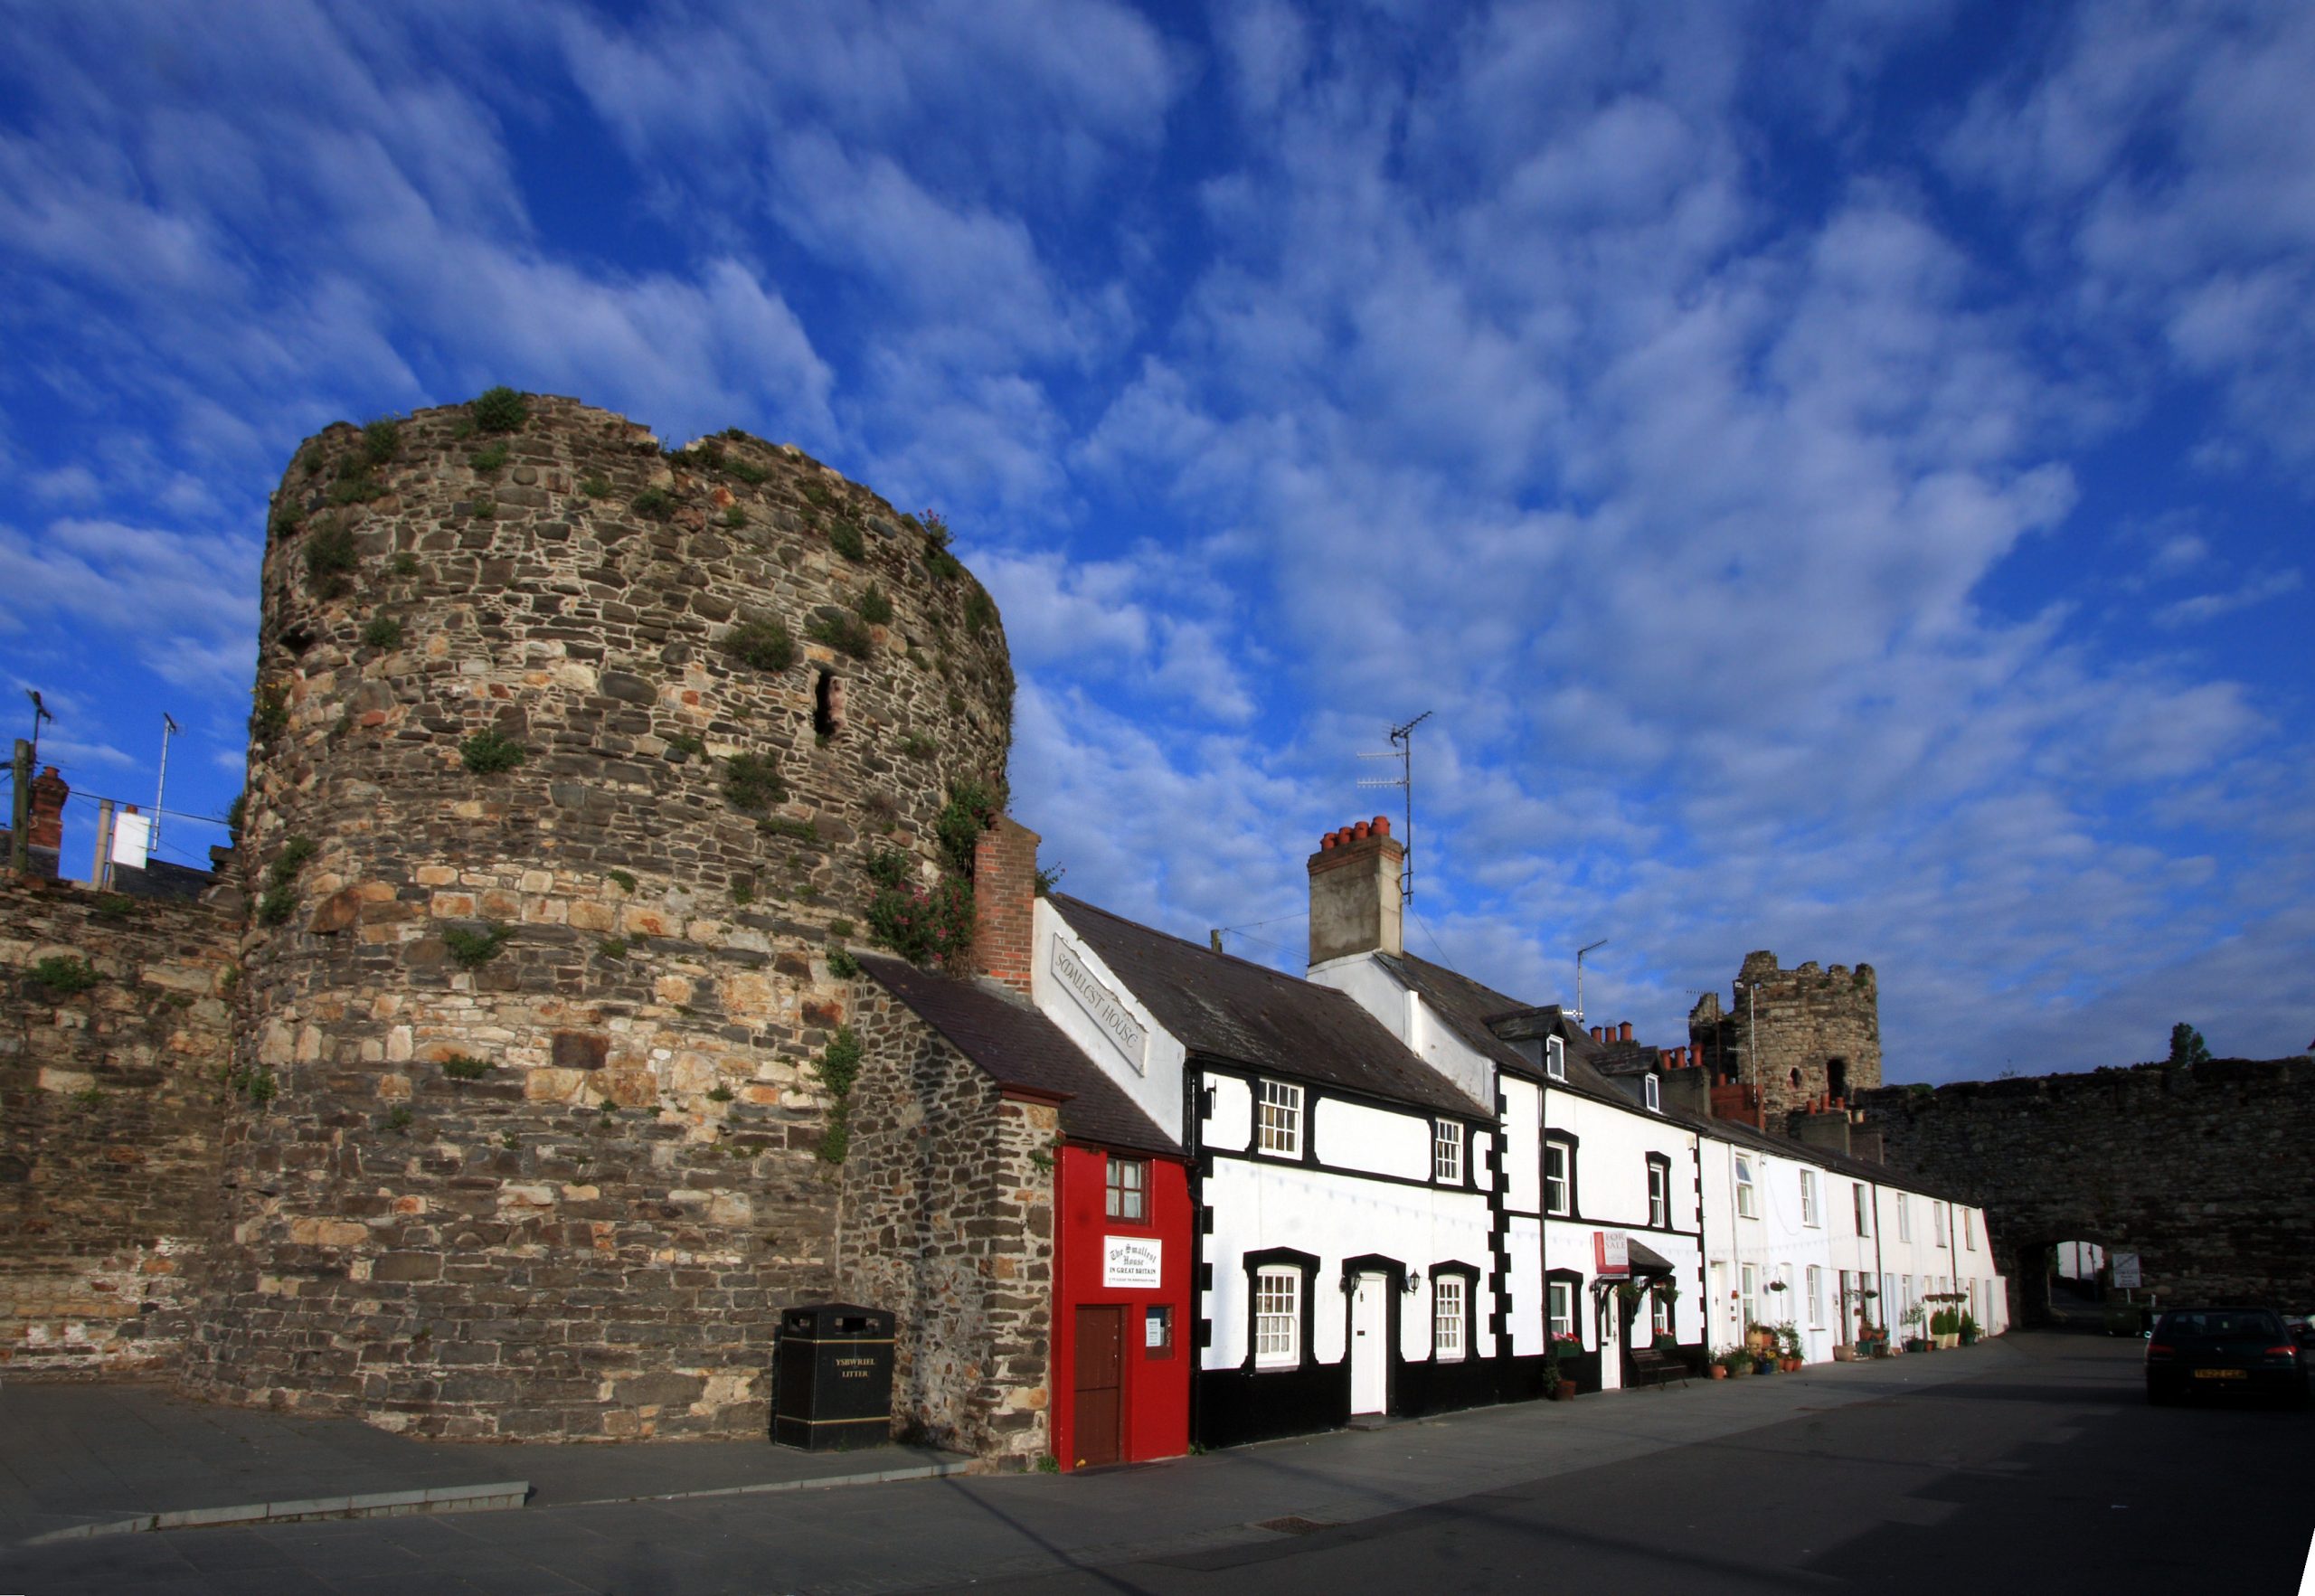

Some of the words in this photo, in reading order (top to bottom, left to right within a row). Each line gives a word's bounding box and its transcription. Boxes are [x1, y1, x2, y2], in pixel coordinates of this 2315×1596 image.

[1055, 953, 1104, 1008] SMALLEST
[1101, 1005, 1138, 1048] HOUSE
[1605, 1232, 1626, 1242] FOR
[1605, 1242, 1626, 1250] SALE
[1110, 1249, 1123, 1261] The
[1125, 1243, 1157, 1263] Smallest
[1123, 1255, 1144, 1266] House
[836, 1358, 875, 1366] YSBWRIEL
